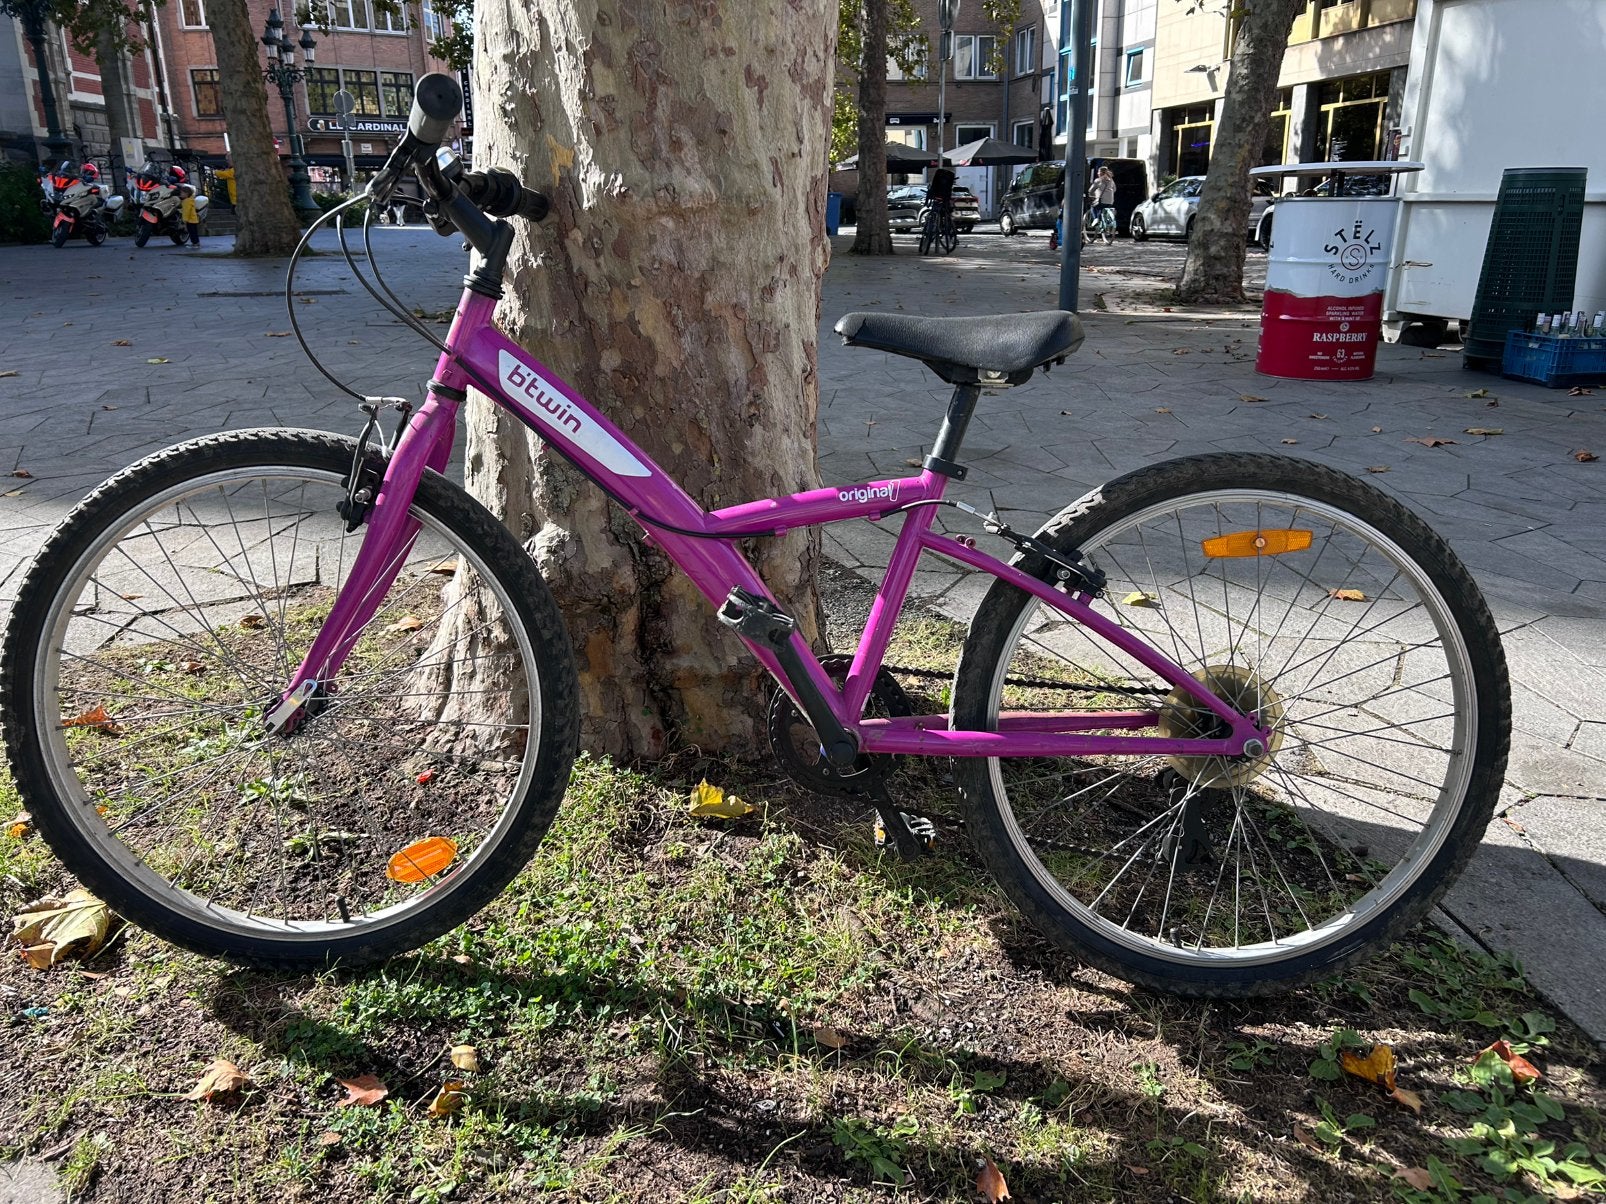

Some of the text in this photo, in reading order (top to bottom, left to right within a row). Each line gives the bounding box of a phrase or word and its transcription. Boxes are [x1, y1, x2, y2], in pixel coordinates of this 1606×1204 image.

[463, 80, 472, 126] CARDINAL
[1324, 220, 1381, 255] STËLZ
[1328, 263, 1375, 284] HARD DRINKS
[1312, 332, 1368, 342] RASPBERRY
[1336, 348, 1345, 358] 63
